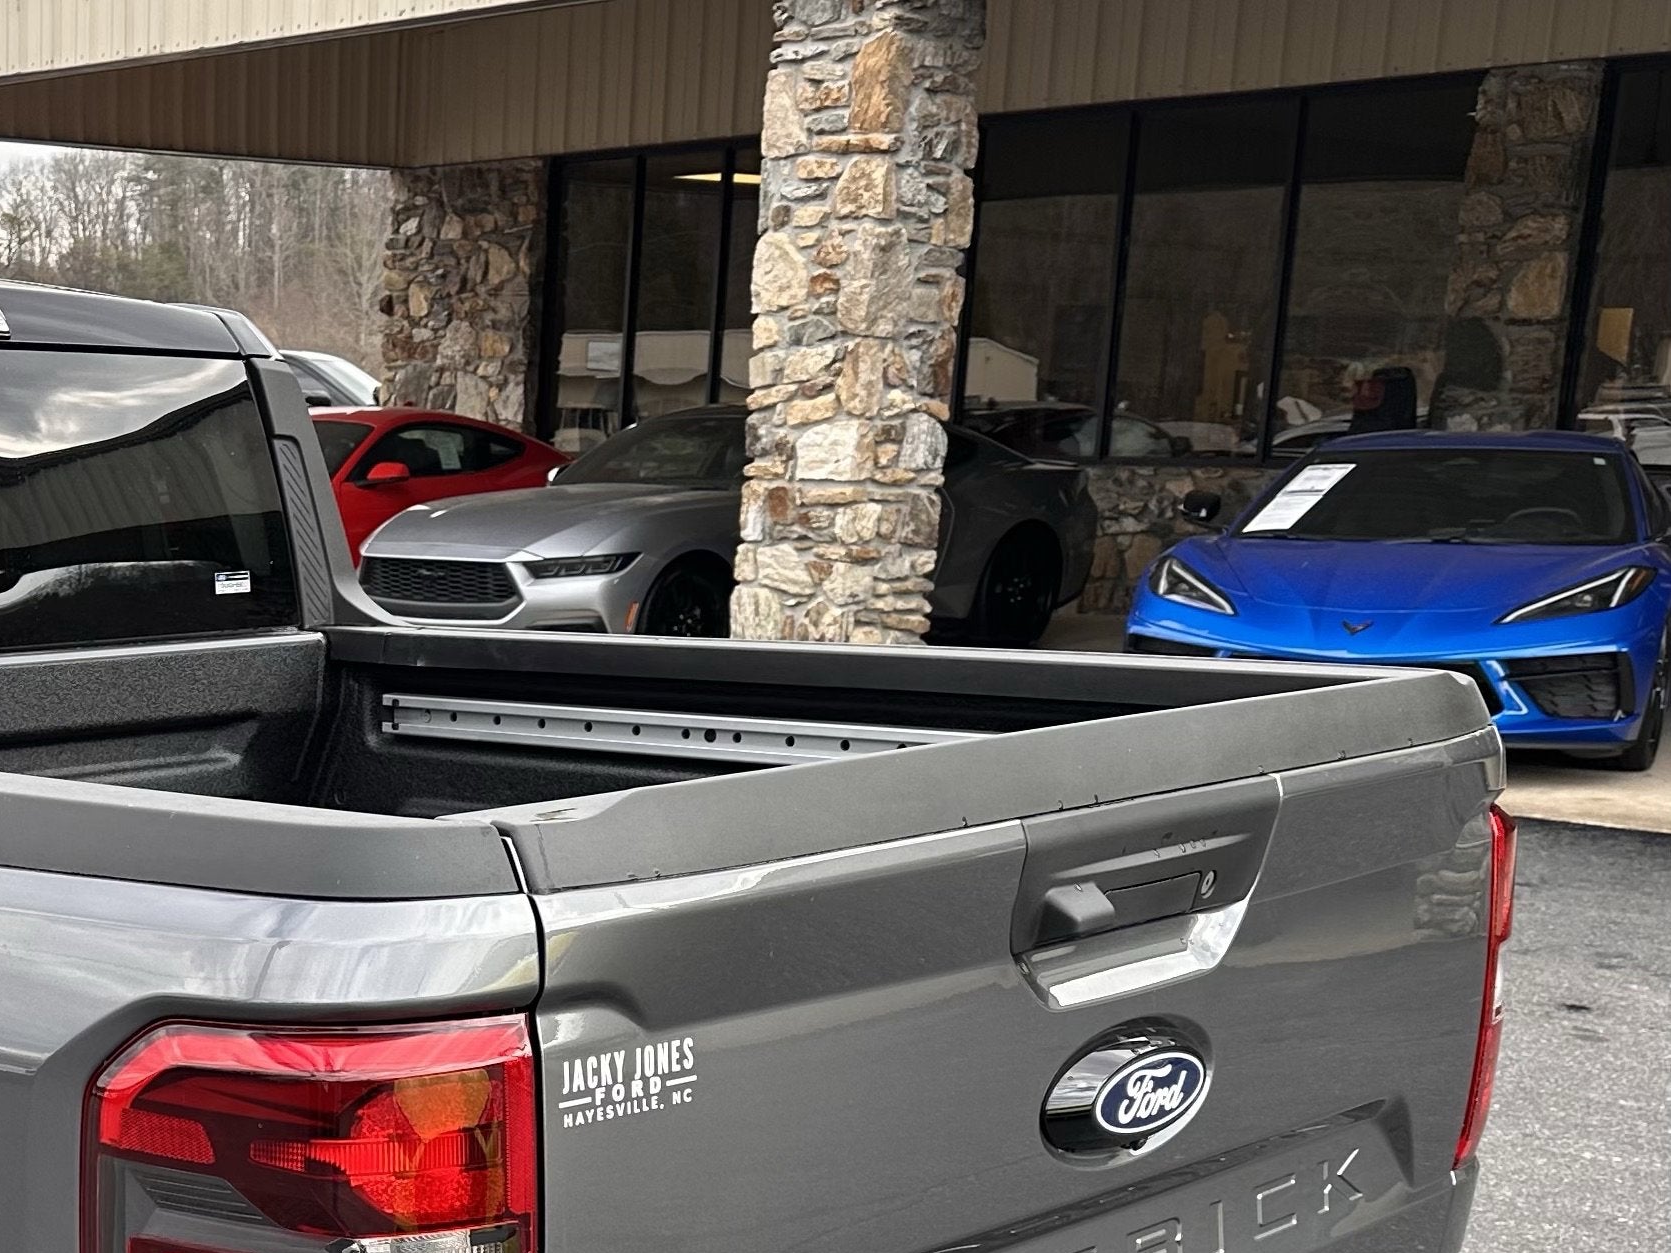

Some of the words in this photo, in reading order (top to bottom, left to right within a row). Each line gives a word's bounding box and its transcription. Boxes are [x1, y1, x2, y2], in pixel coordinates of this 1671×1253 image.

[562, 1050, 626, 1094] JACKY
[634, 1037, 695, 1080] JONES
[563, 1096, 665, 1129] HAYESVILLE,
[671, 1088, 693, 1105] NC
[594, 1076, 663, 1106] FORD
[1118, 1066, 1185, 1125] Ford
